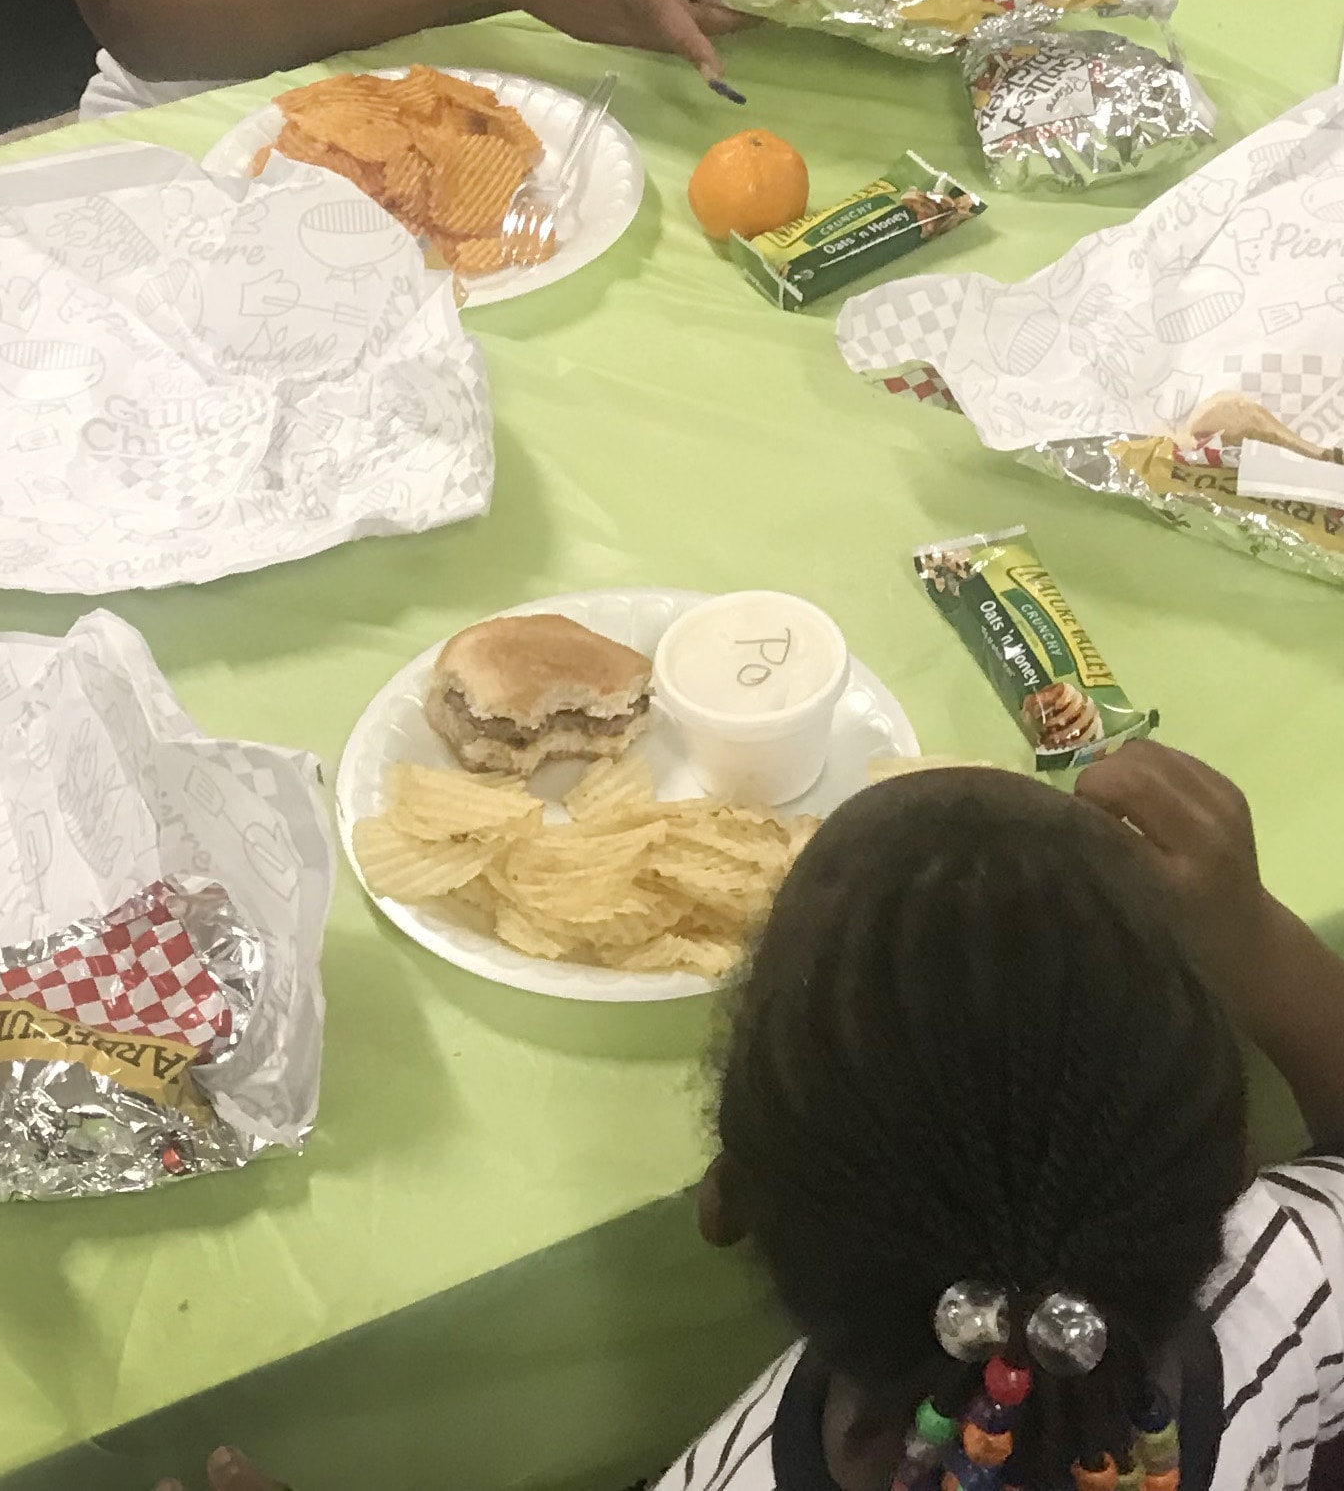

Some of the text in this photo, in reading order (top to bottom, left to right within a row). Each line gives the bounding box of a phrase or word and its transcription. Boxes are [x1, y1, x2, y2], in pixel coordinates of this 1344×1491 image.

[819, 202, 873, 236] CRUNCHY
[822, 236, 854, 255] Oats
[867, 209, 910, 233] Honey
[979, 599, 1004, 631] Oats
[1012, 643, 1041, 686] Honey
[1017, 565, 1115, 681] NATURE VALLEY
[1020, 603, 1063, 657] CRUNCHY
